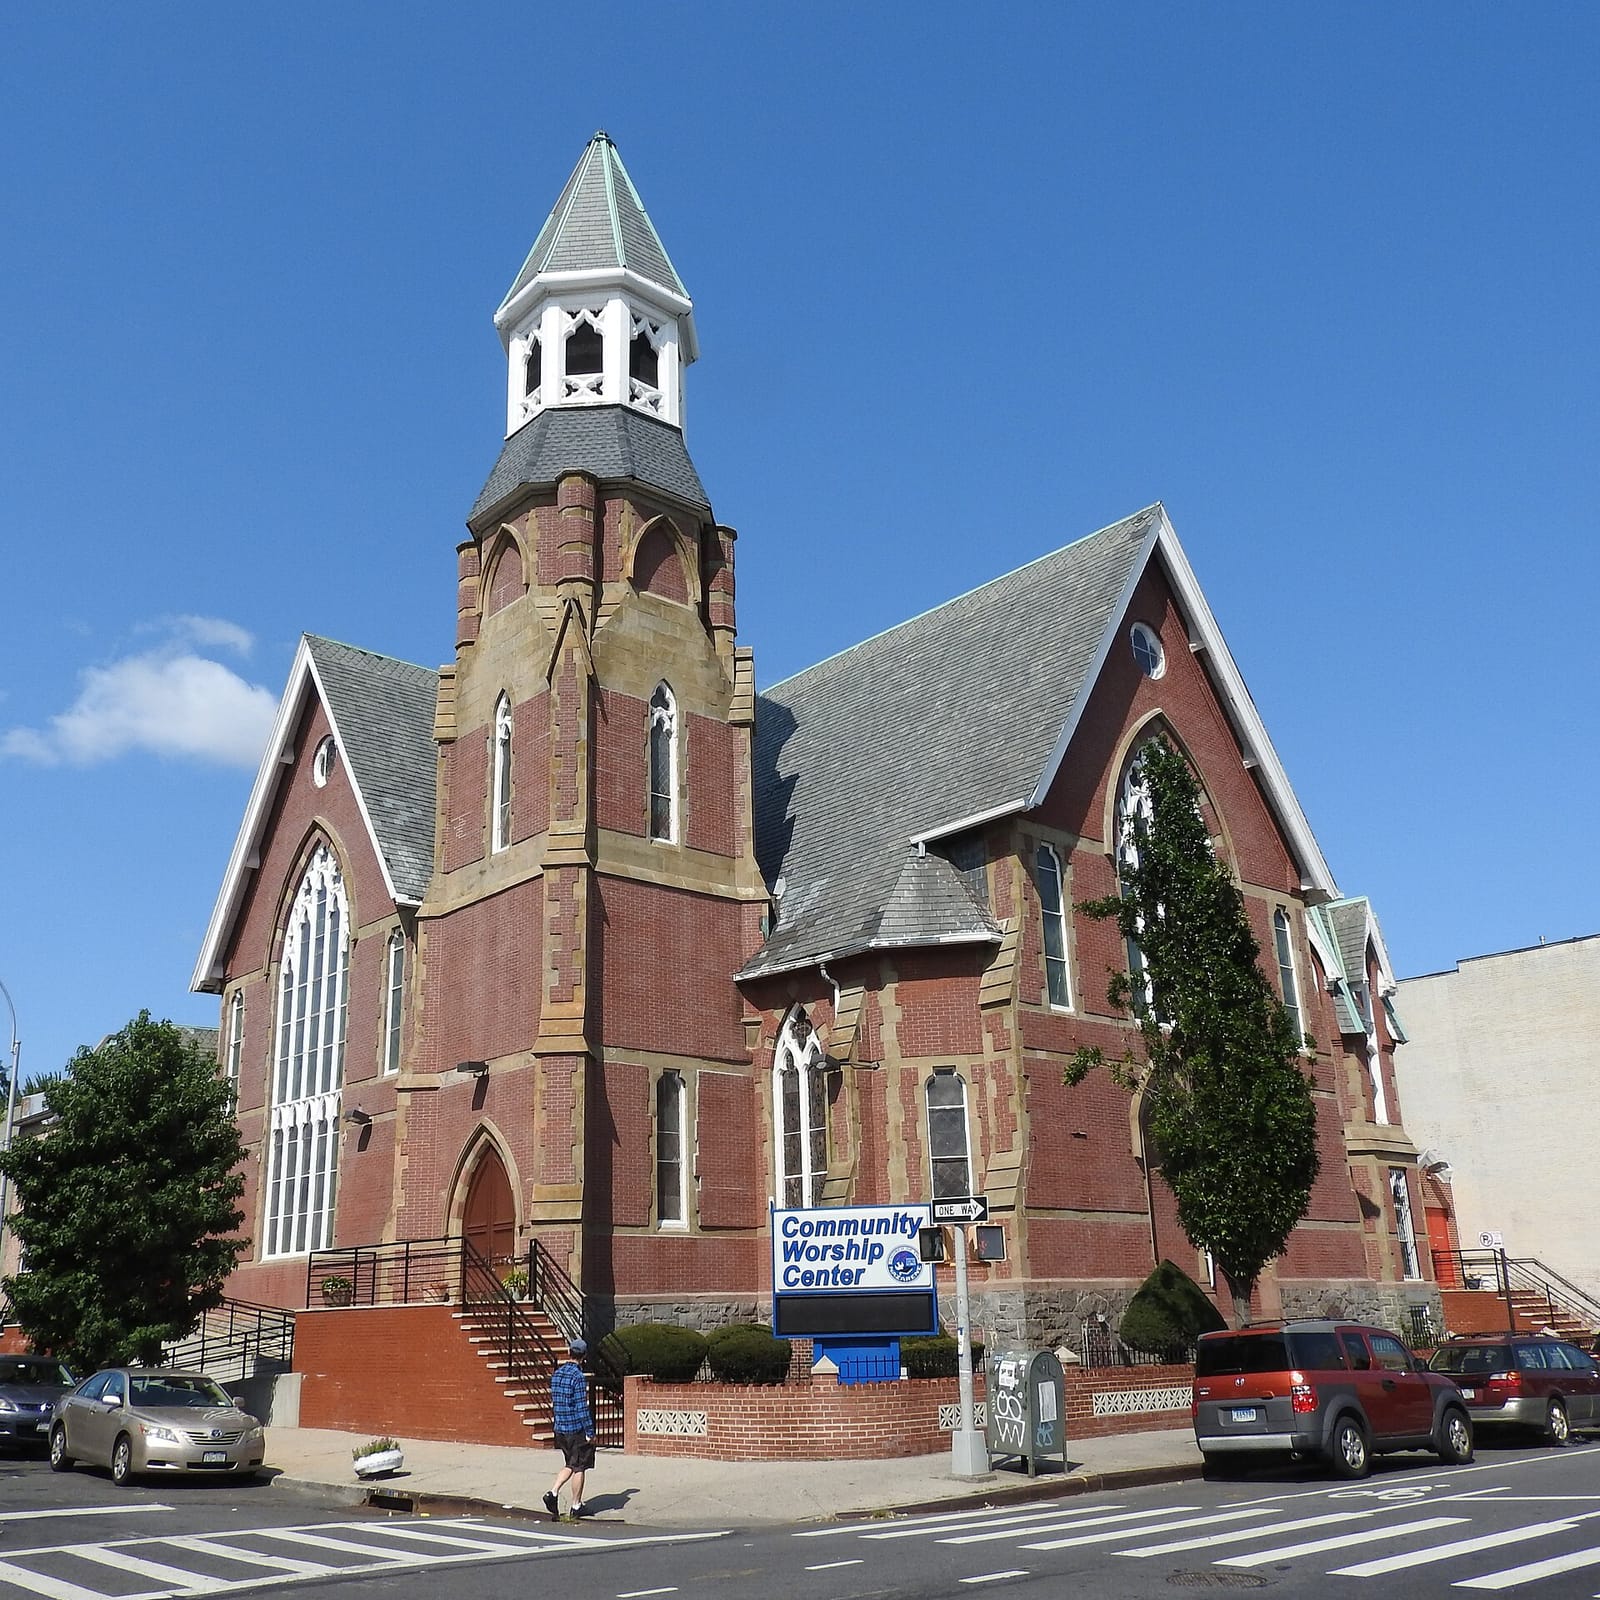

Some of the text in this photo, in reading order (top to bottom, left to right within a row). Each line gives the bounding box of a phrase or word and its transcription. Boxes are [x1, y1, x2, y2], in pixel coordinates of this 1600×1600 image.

[938, 1204, 978, 1216] ONE WAY
[781, 1212, 923, 1239] Community
[782, 1238, 884, 1265] Worship
[783, 1264, 865, 1287] Center
